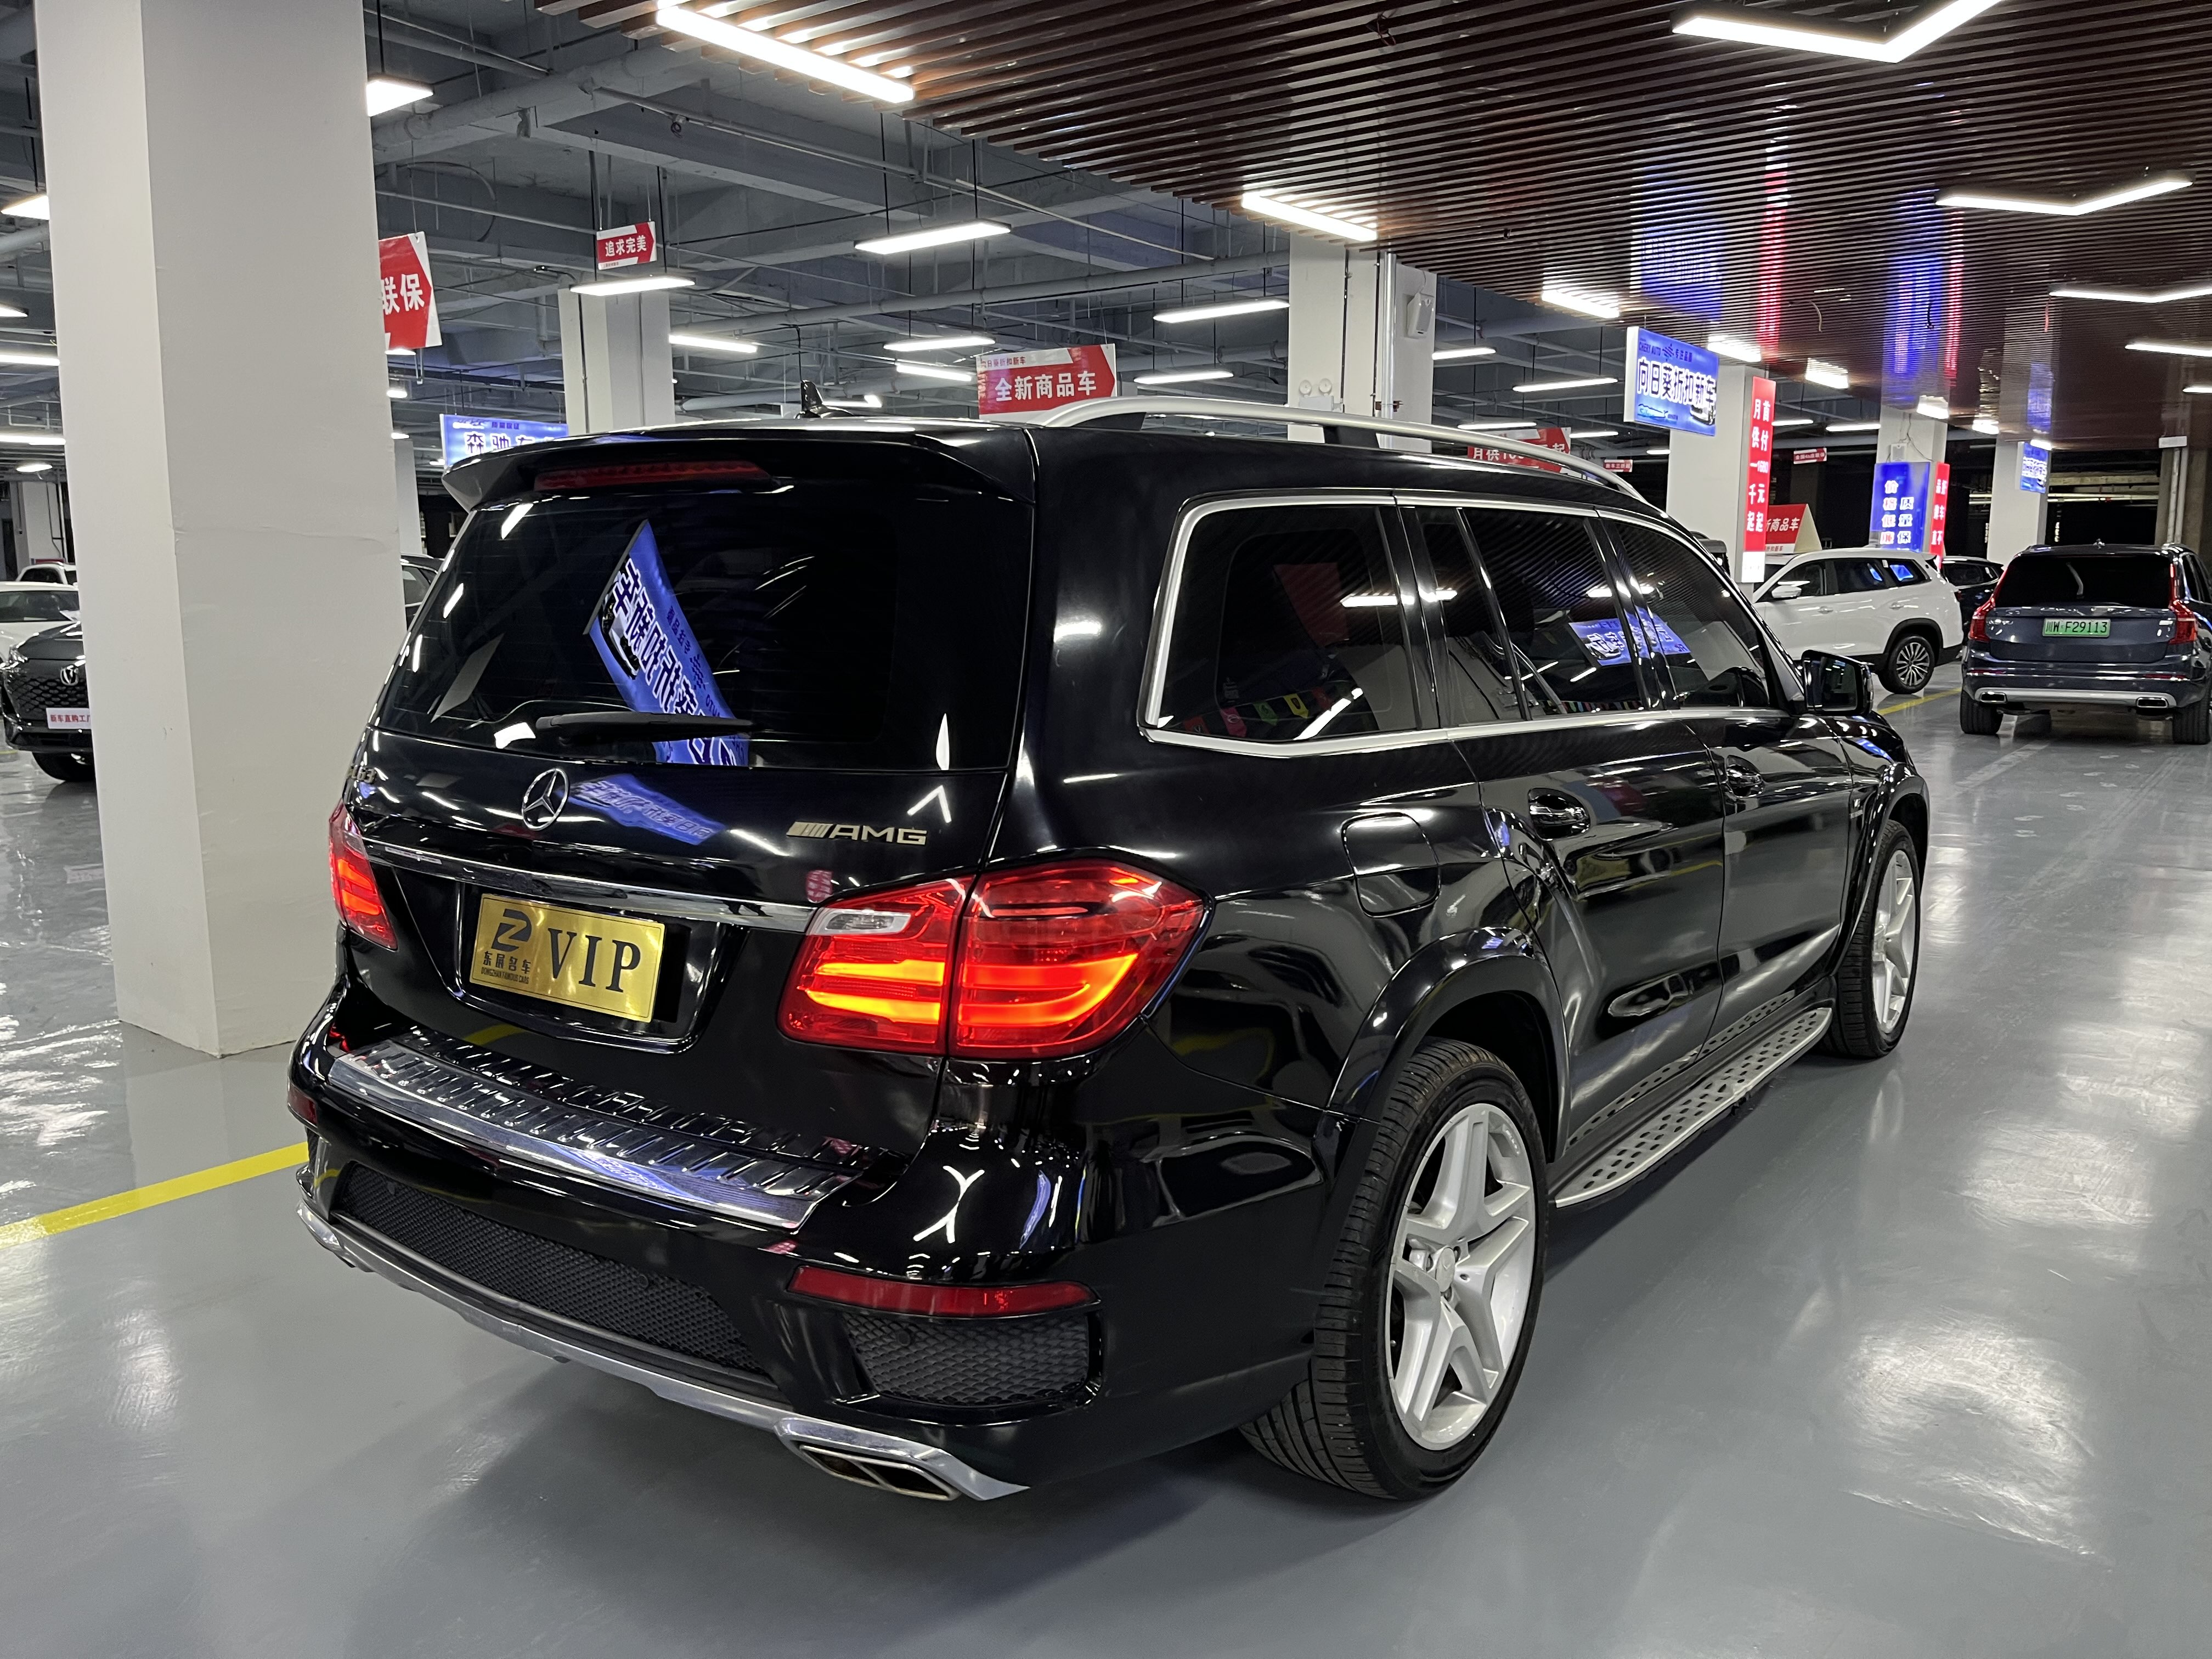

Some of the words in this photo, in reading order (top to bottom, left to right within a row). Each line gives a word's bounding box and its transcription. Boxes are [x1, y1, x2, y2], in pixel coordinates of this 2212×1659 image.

[605, 234, 647, 257] 追求完美
[995, 370, 1097, 402] 全新商品车
[1637, 357, 1717, 411] 向日葵折扣新车
[1897, 496, 1915, 551] 质量保
[829, 824, 927, 845] AMG
[548, 927, 641, 993] VIP
